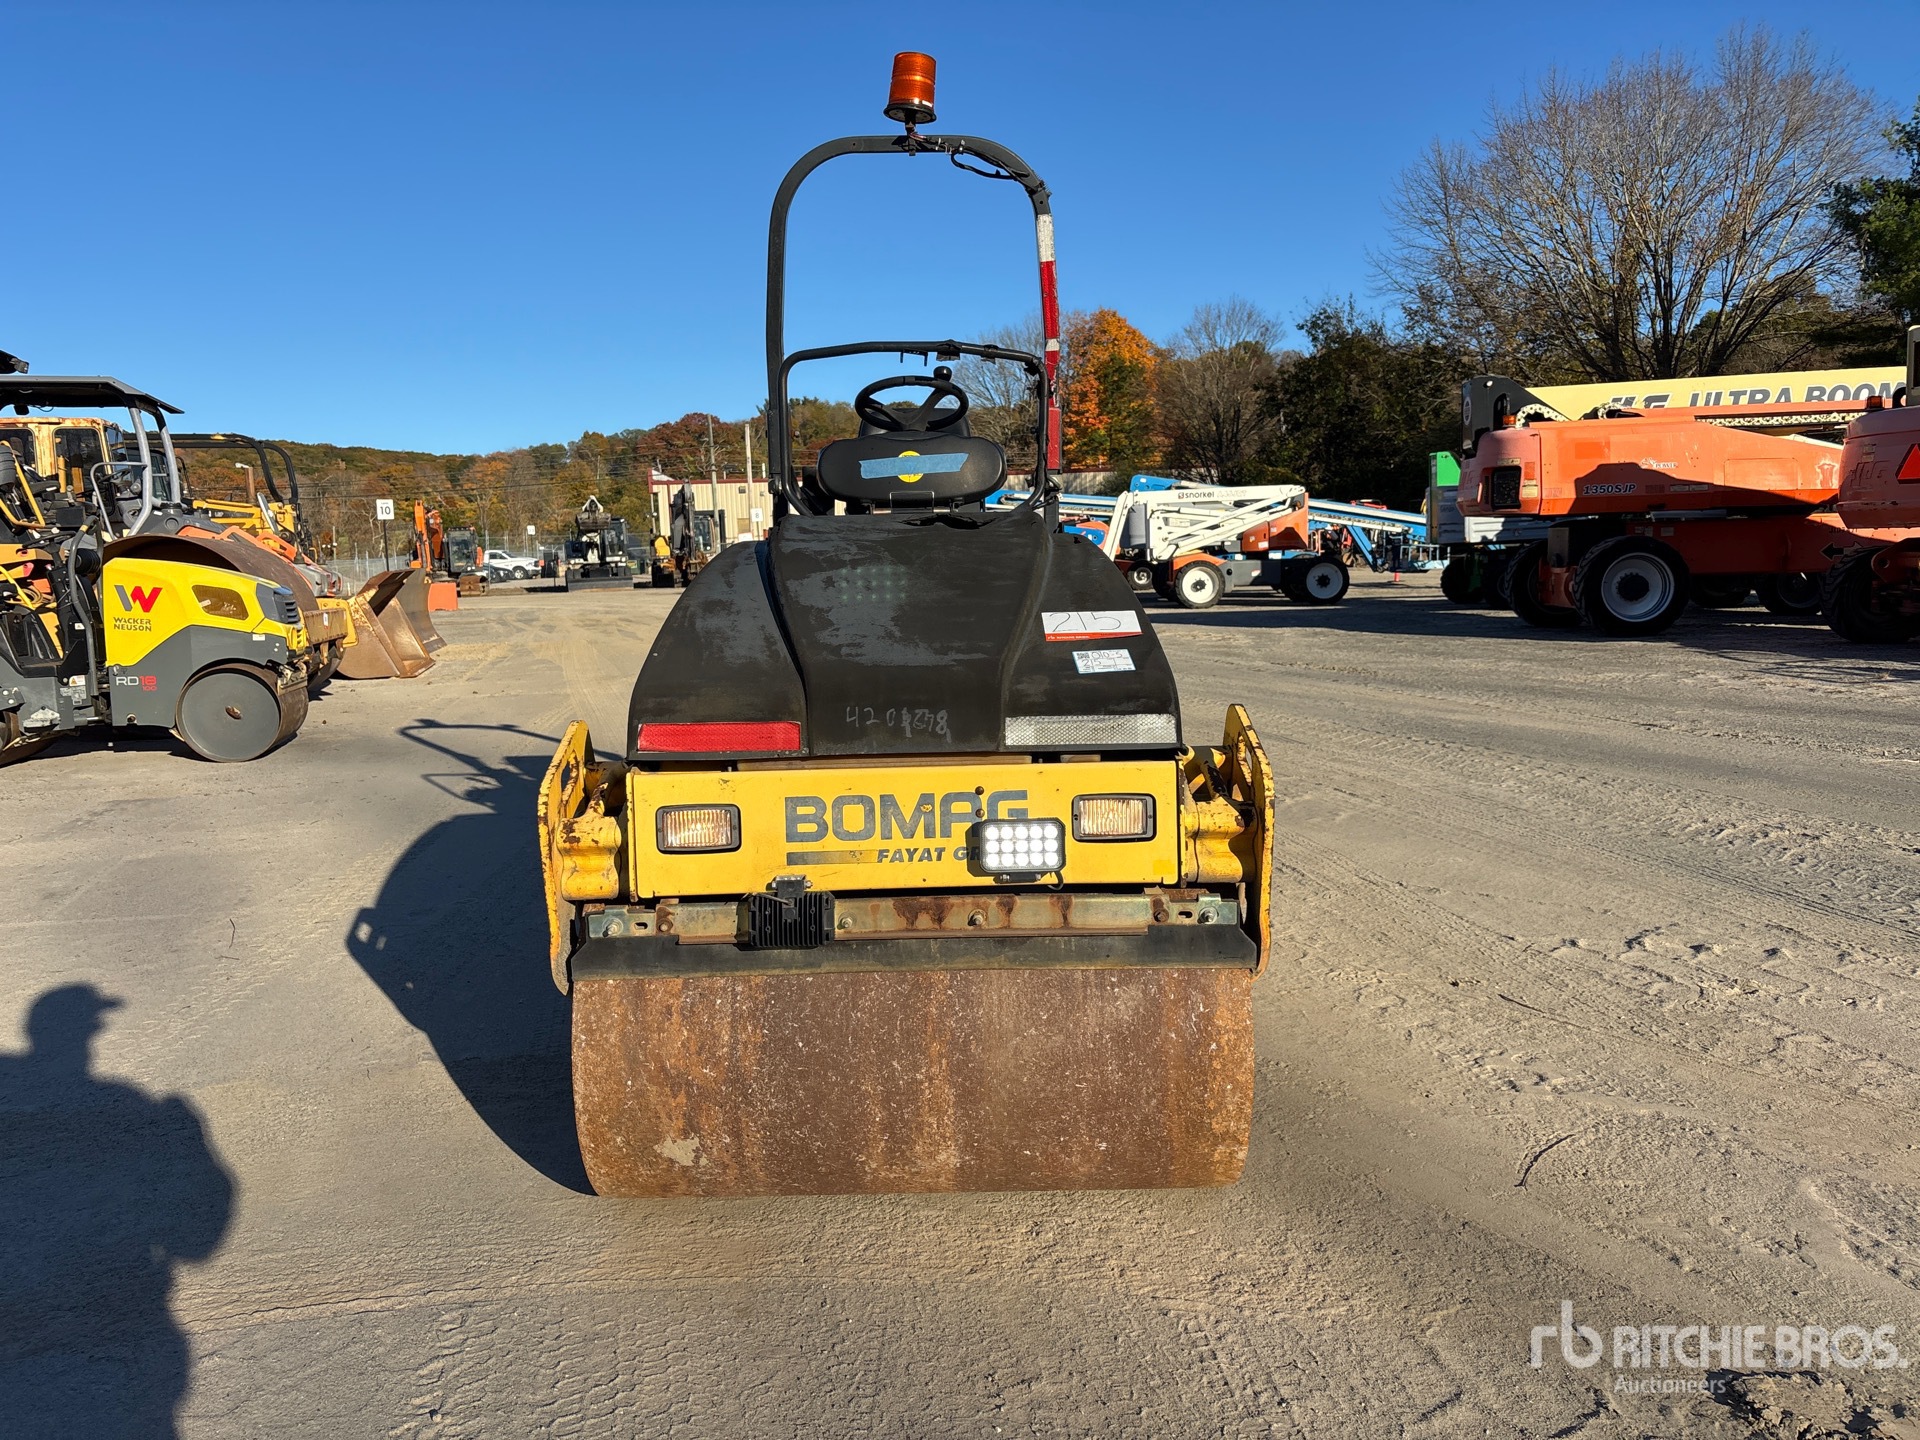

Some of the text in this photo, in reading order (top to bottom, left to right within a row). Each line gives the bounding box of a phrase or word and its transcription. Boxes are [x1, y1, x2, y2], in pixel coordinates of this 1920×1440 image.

[1582, 484, 1637, 495] 1350SJP
[1185, 491, 1215, 499] snorkel
[380, 506, 391, 515] 10
[113, 616, 152, 625] WACKER
[1049, 611, 1122, 633] 215
[113, 623, 152, 632] NEUSON
[784, 790, 1028, 843] BOMAG
[876, 846, 981, 864] FAYAT GR
